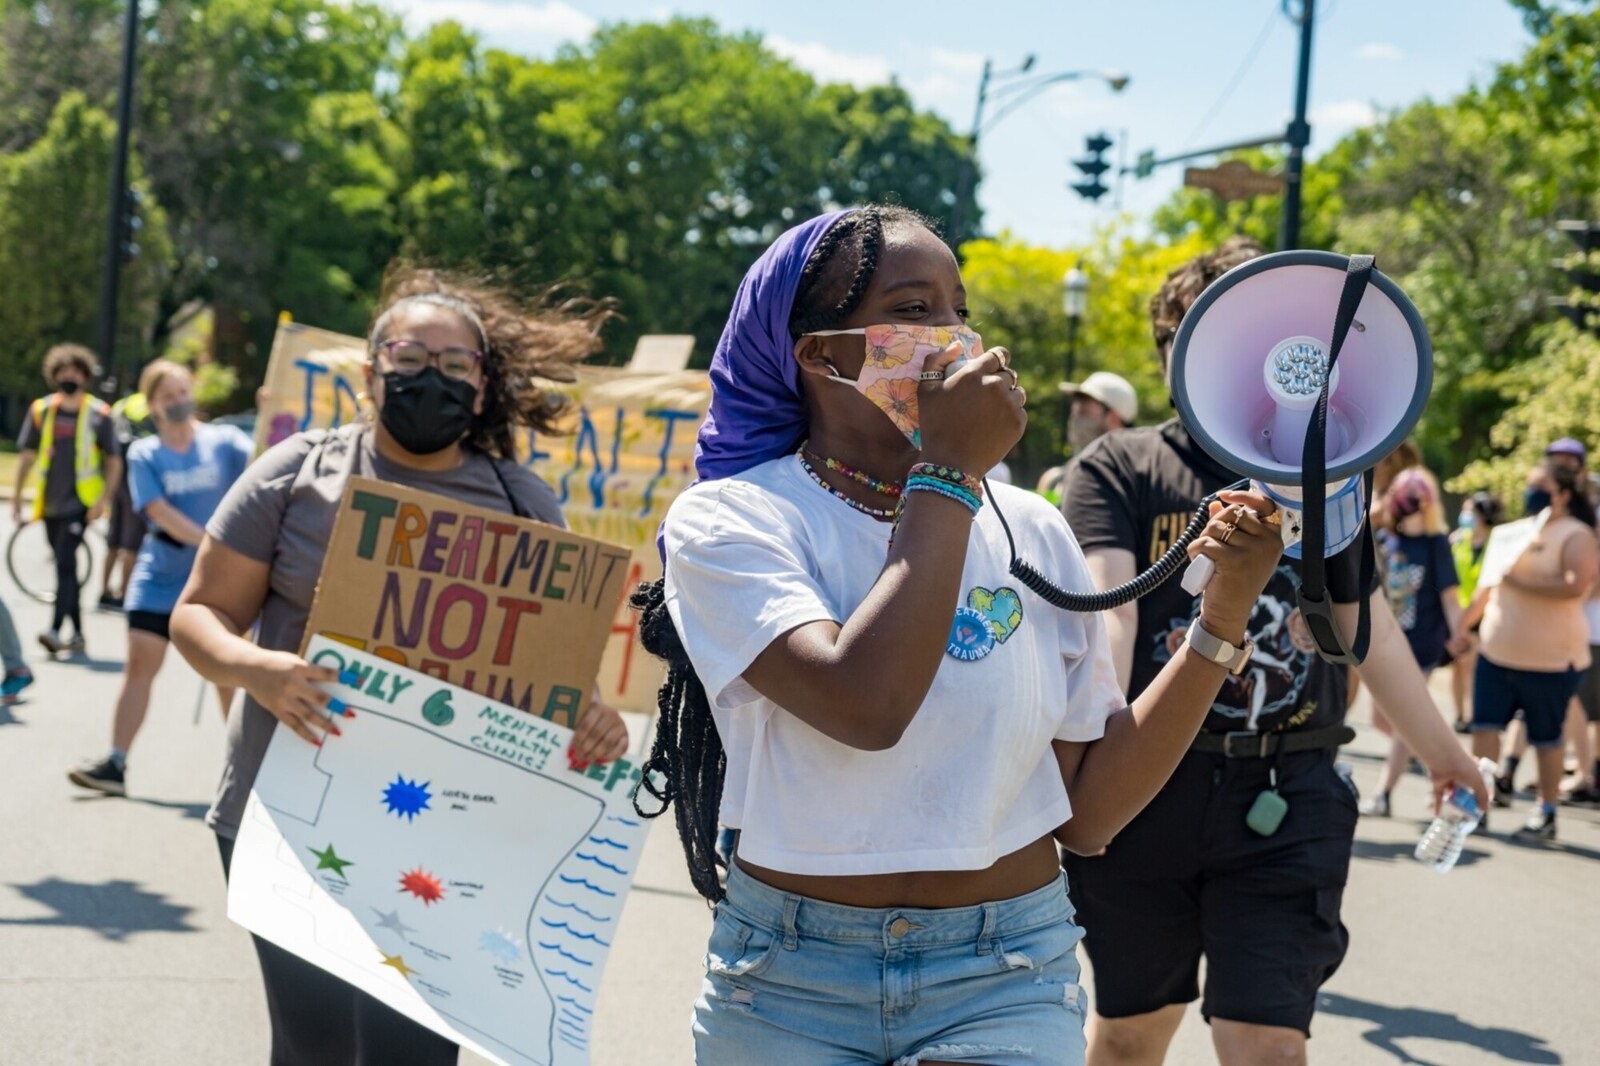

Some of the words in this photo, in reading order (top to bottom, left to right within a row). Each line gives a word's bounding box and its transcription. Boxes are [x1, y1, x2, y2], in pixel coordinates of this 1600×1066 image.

[350, 489, 632, 610] TREATMENT
[372, 571, 542, 666] NOT
[955, 607, 996, 640] EATMENT
[947, 643, 991, 660] TRAUMA
[421, 688, 455, 727] 6
[478, 705, 562, 748] MENTAL
[484, 725, 551, 759] HEALTH
[567, 758, 657, 800] EFT
